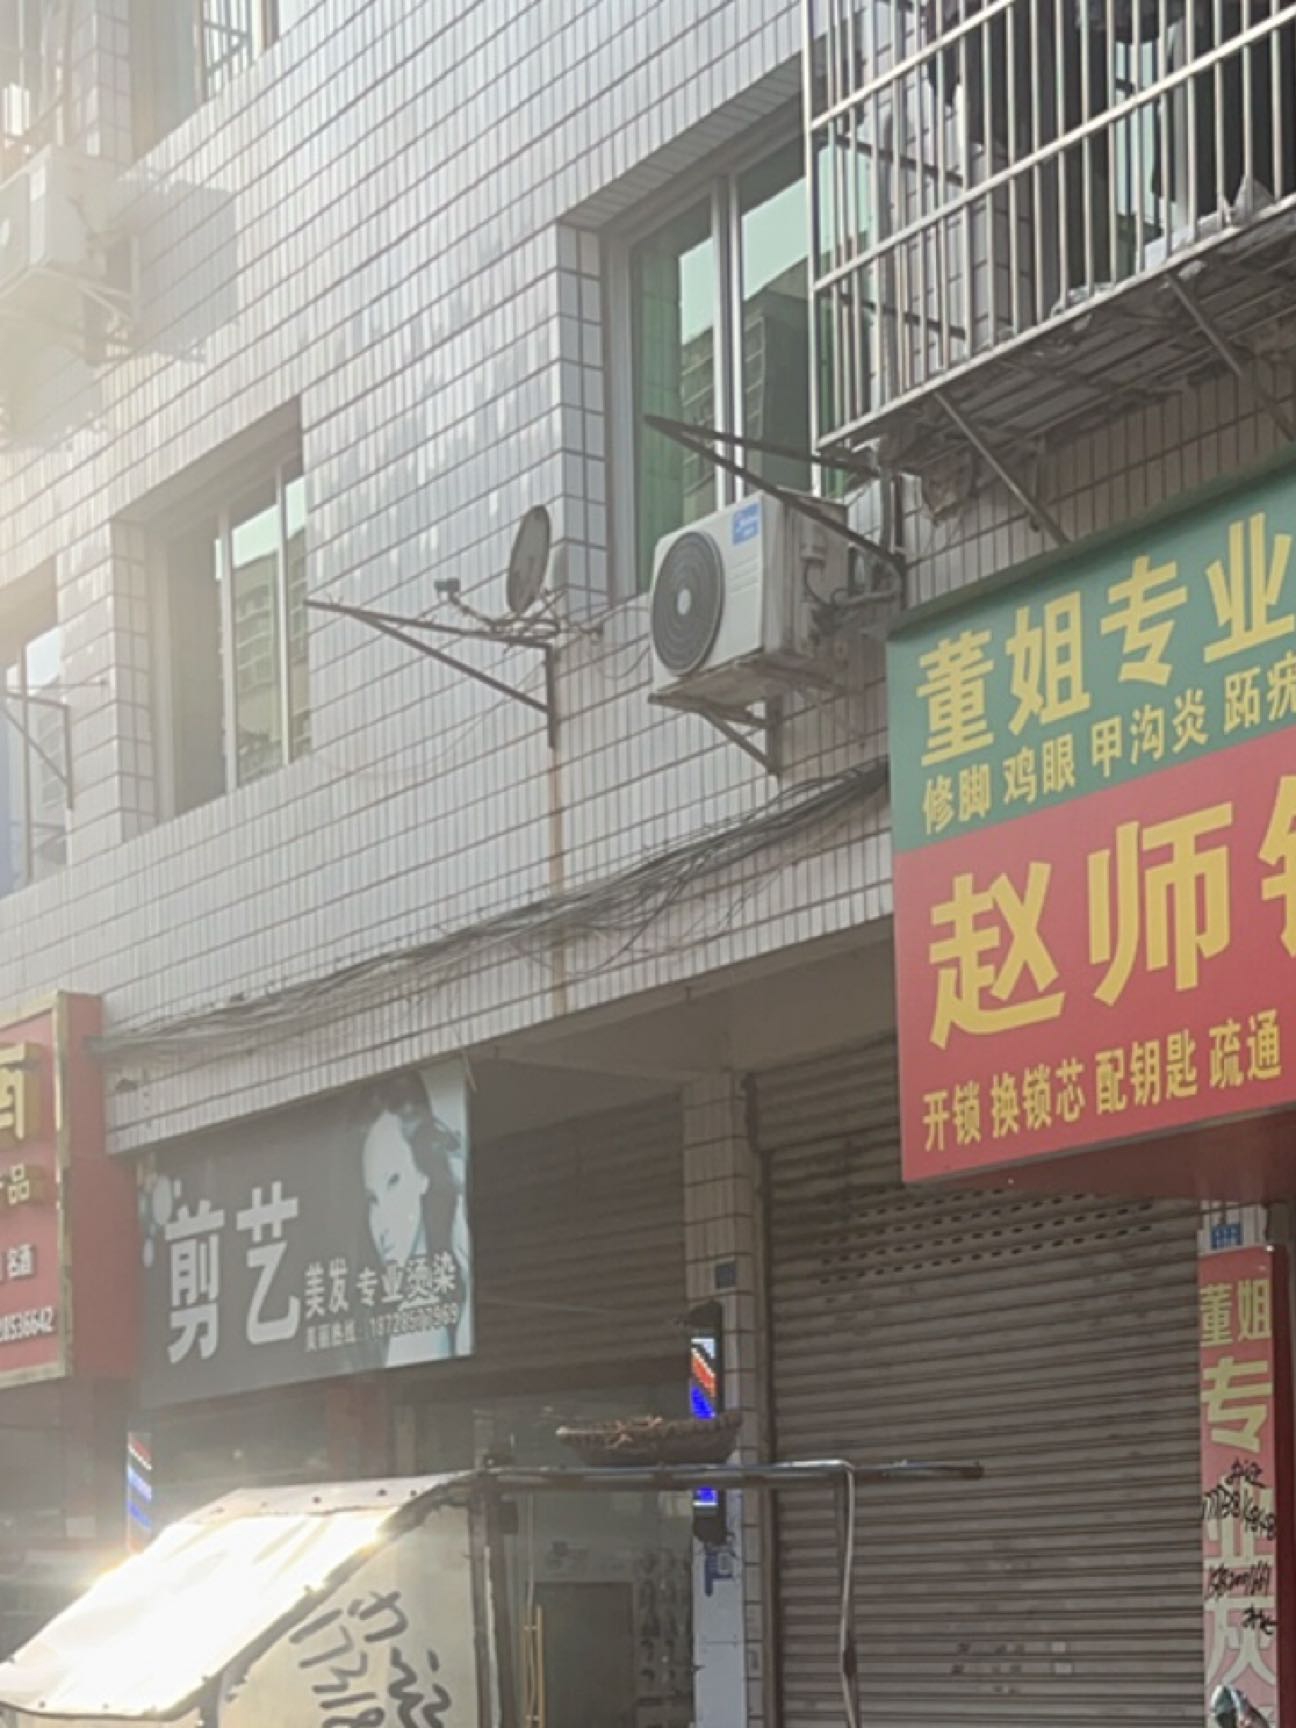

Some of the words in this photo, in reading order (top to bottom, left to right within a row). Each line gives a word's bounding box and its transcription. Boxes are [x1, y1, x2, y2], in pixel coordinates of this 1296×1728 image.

[922, 763, 991, 836] 修脚
[1003, 733, 1077, 804] 鸡眼
[1091, 689, 1208, 777] 甲沟炎
[922, 1081, 981, 1152] 开锁
[990, 1057, 1085, 1138] 换锁芯
[1095, 1029, 1198, 1115] 配钥匙
[1209, 1009, 1281, 1088] 疏通
[165, 1180, 300, 1364] 剪艺
[304, 1256, 348, 1320] 美发
[1200, 1279, 1271, 1347] 董姐
